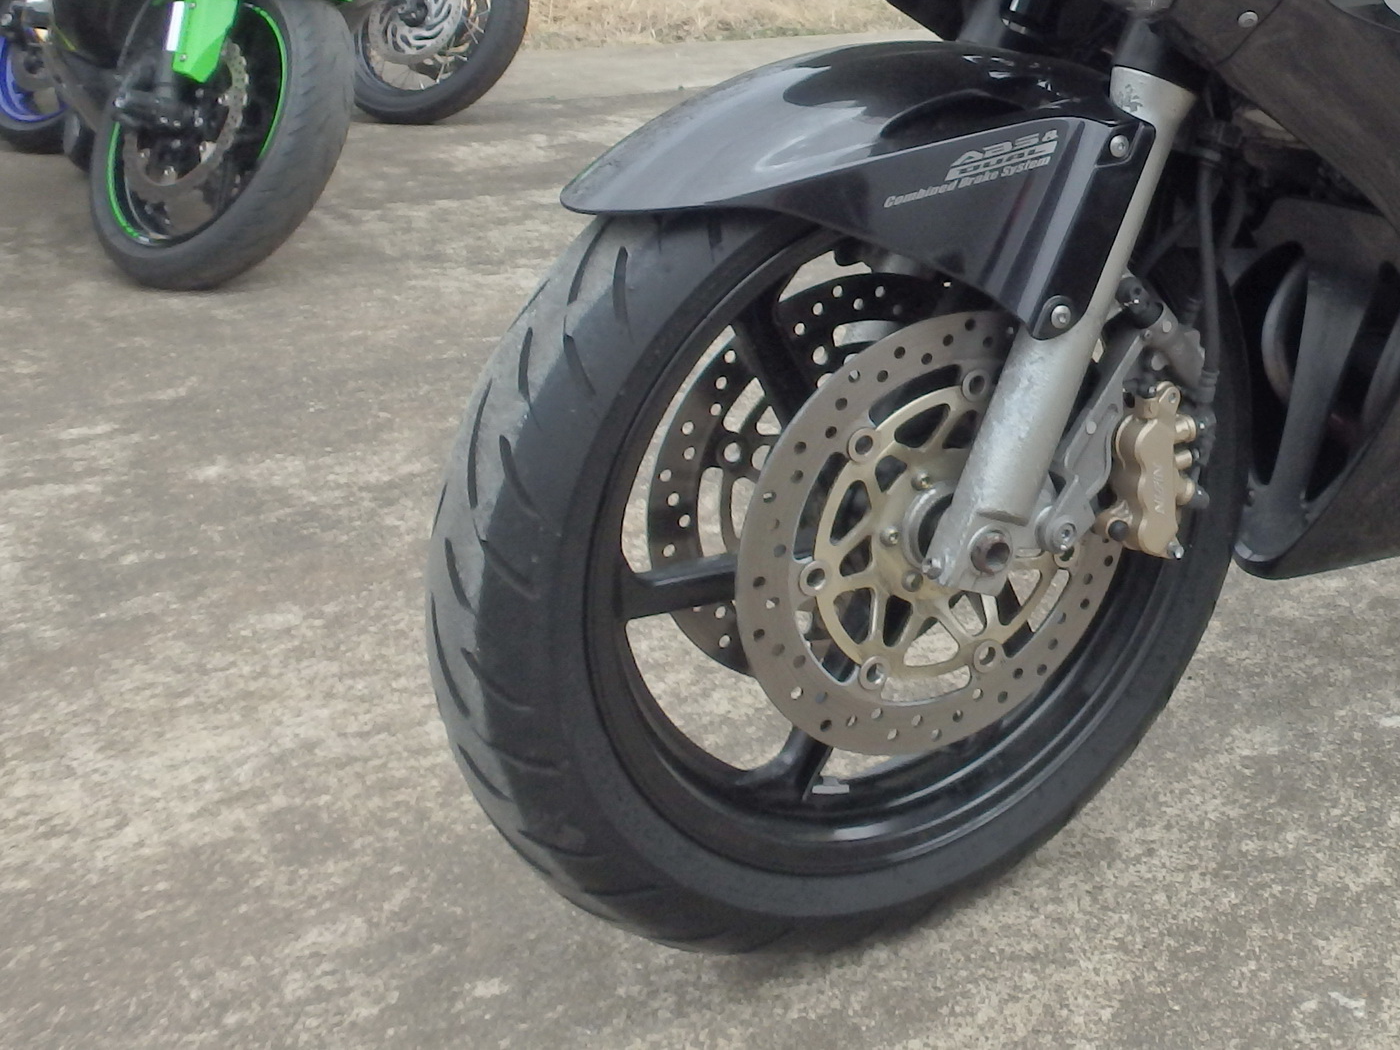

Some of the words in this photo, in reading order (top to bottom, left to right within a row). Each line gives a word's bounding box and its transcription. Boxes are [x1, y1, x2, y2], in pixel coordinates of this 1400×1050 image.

[950, 133, 1039, 166] ABS
[1042, 129, 1059, 142] &
[884, 179, 958, 208] Combined
[958, 169, 999, 189] Brake
[1001, 156, 1051, 178] System
